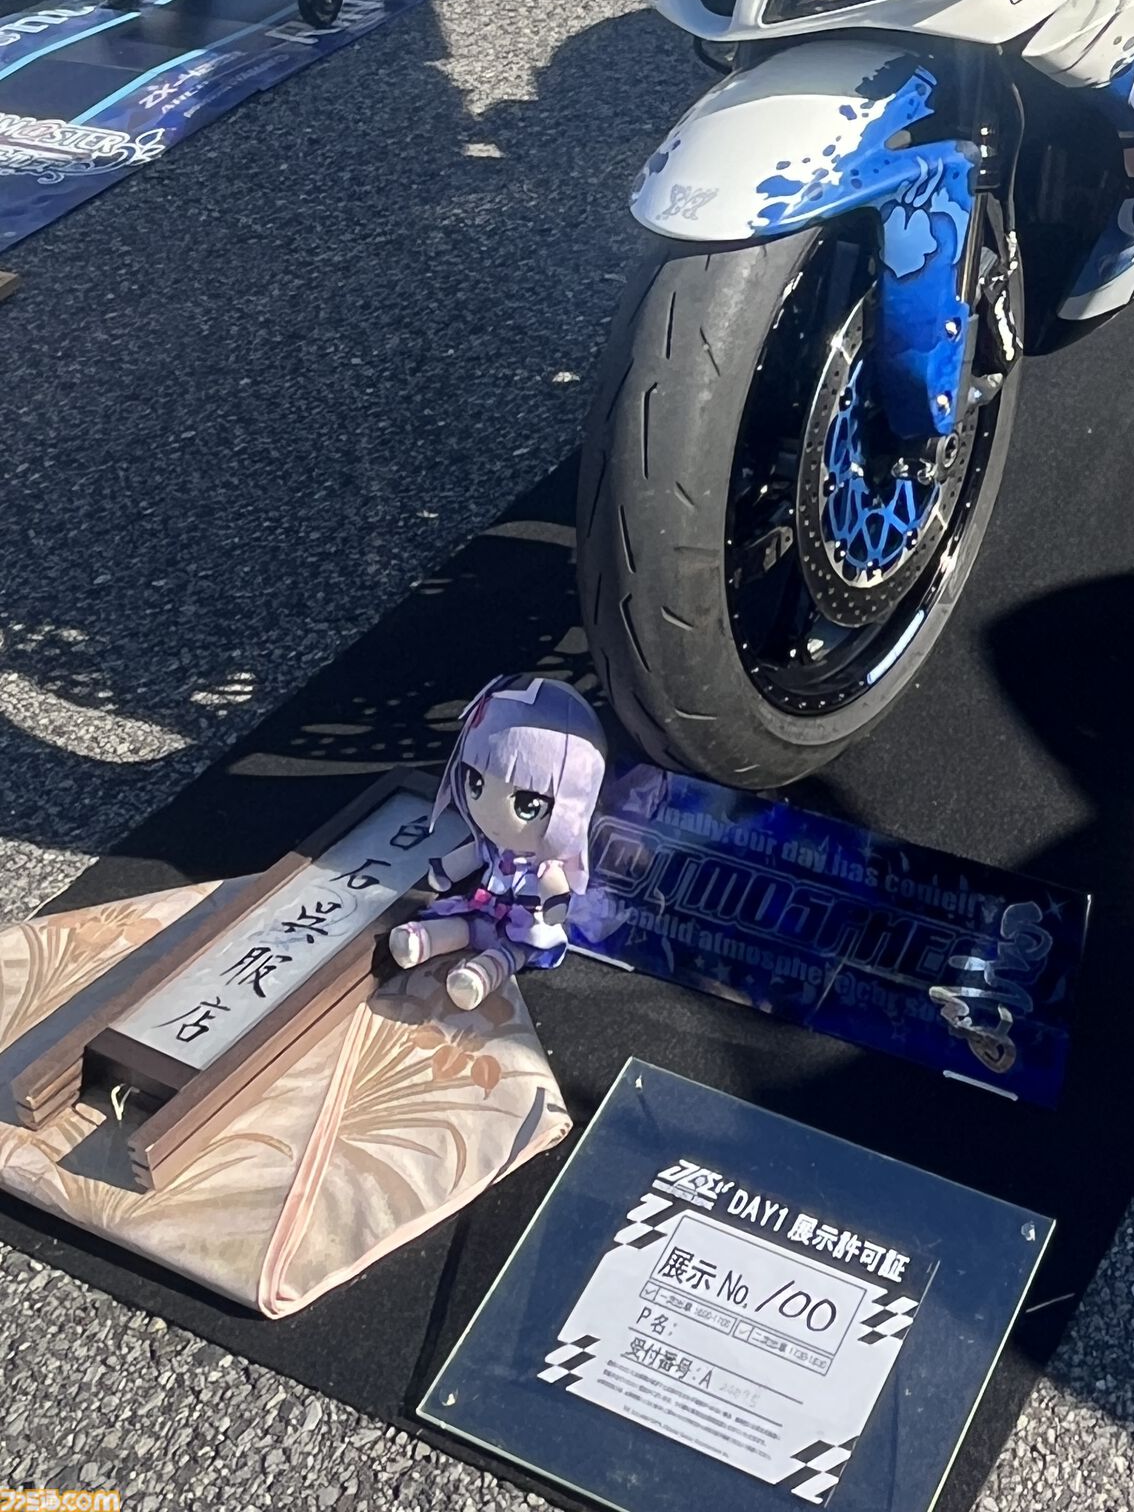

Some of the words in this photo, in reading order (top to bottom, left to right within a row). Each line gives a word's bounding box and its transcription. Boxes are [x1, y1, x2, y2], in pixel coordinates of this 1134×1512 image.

[727, 1188, 788, 1232] DAY1
[787, 1213, 910, 1284] 展示許可証
